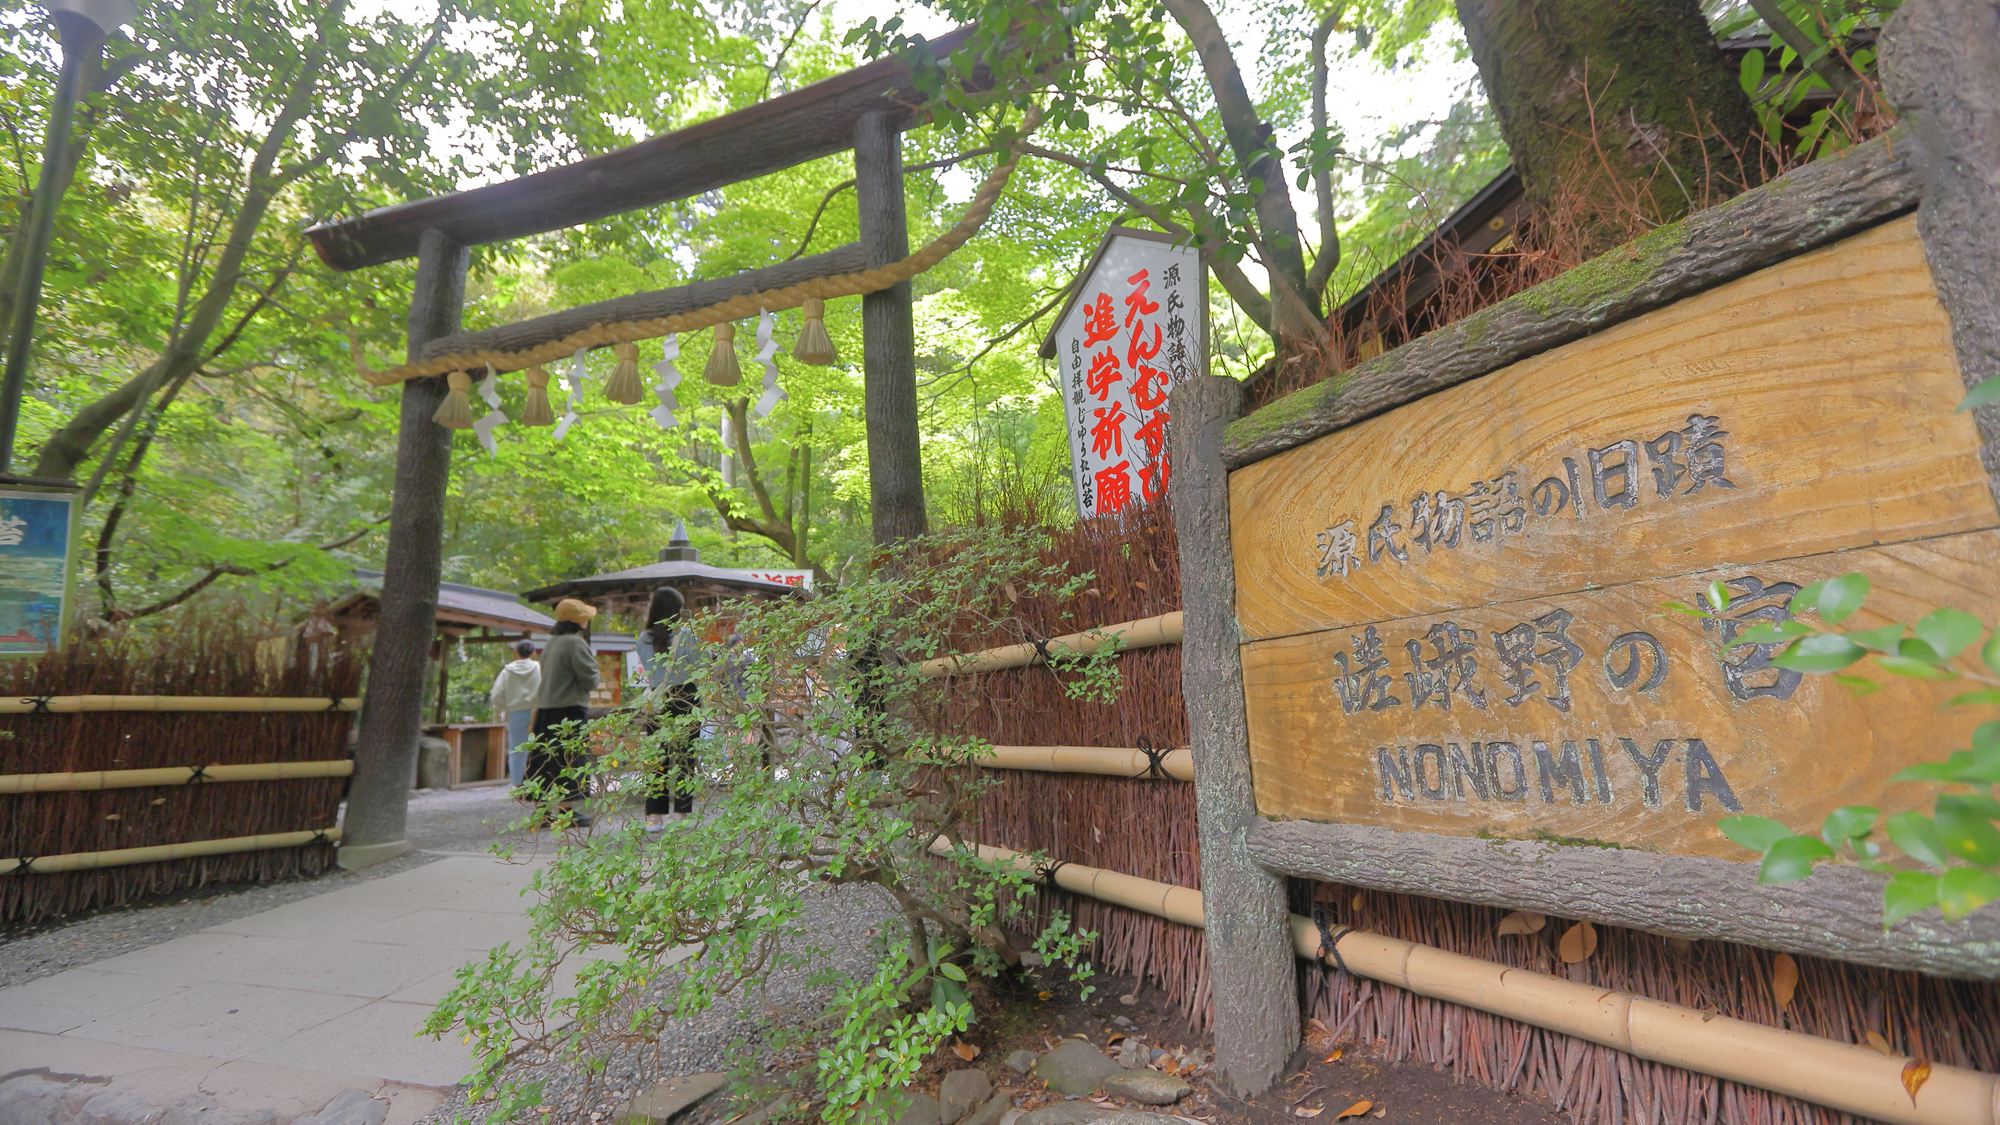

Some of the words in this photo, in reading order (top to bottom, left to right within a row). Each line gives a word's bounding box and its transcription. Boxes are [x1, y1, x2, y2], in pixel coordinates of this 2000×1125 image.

[1083, 292, 1131, 515] 進学祈願
[1333, 575, 1803, 714] 嵯峨野の宮
[1376, 737, 1742, 814] NONOMIYA
